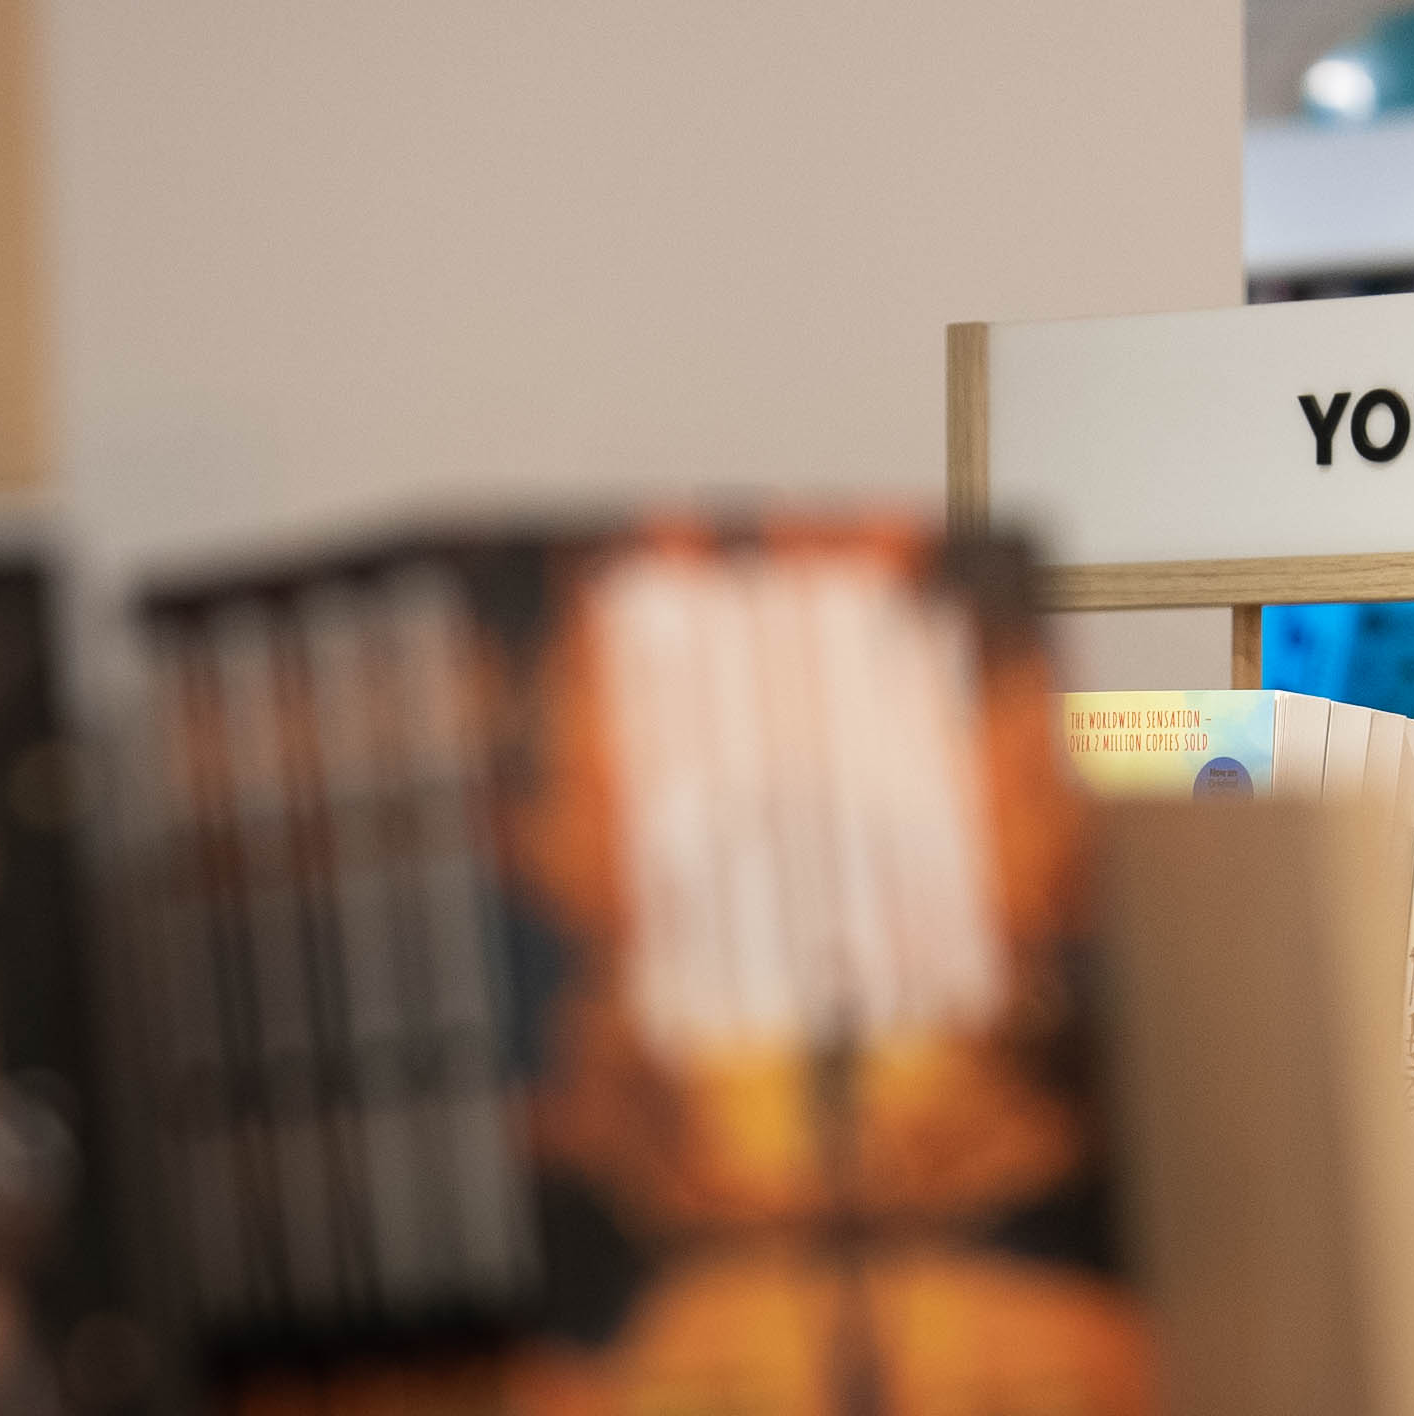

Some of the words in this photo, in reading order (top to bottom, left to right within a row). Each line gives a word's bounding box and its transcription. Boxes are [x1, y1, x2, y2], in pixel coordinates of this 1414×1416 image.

[1071, 711, 1084, 730] THE
[1089, 711, 1141, 730] WORLDWIDE
[1146, 710, 1200, 729] SENSATION
[1070, 734, 1090, 752] OVER
[1094, 735, 1100, 752] 2
[1103, 734, 1141, 752] MILLION
[1146, 734, 1179, 752] COPIES
[1184, 733, 1208, 751] SOLD
